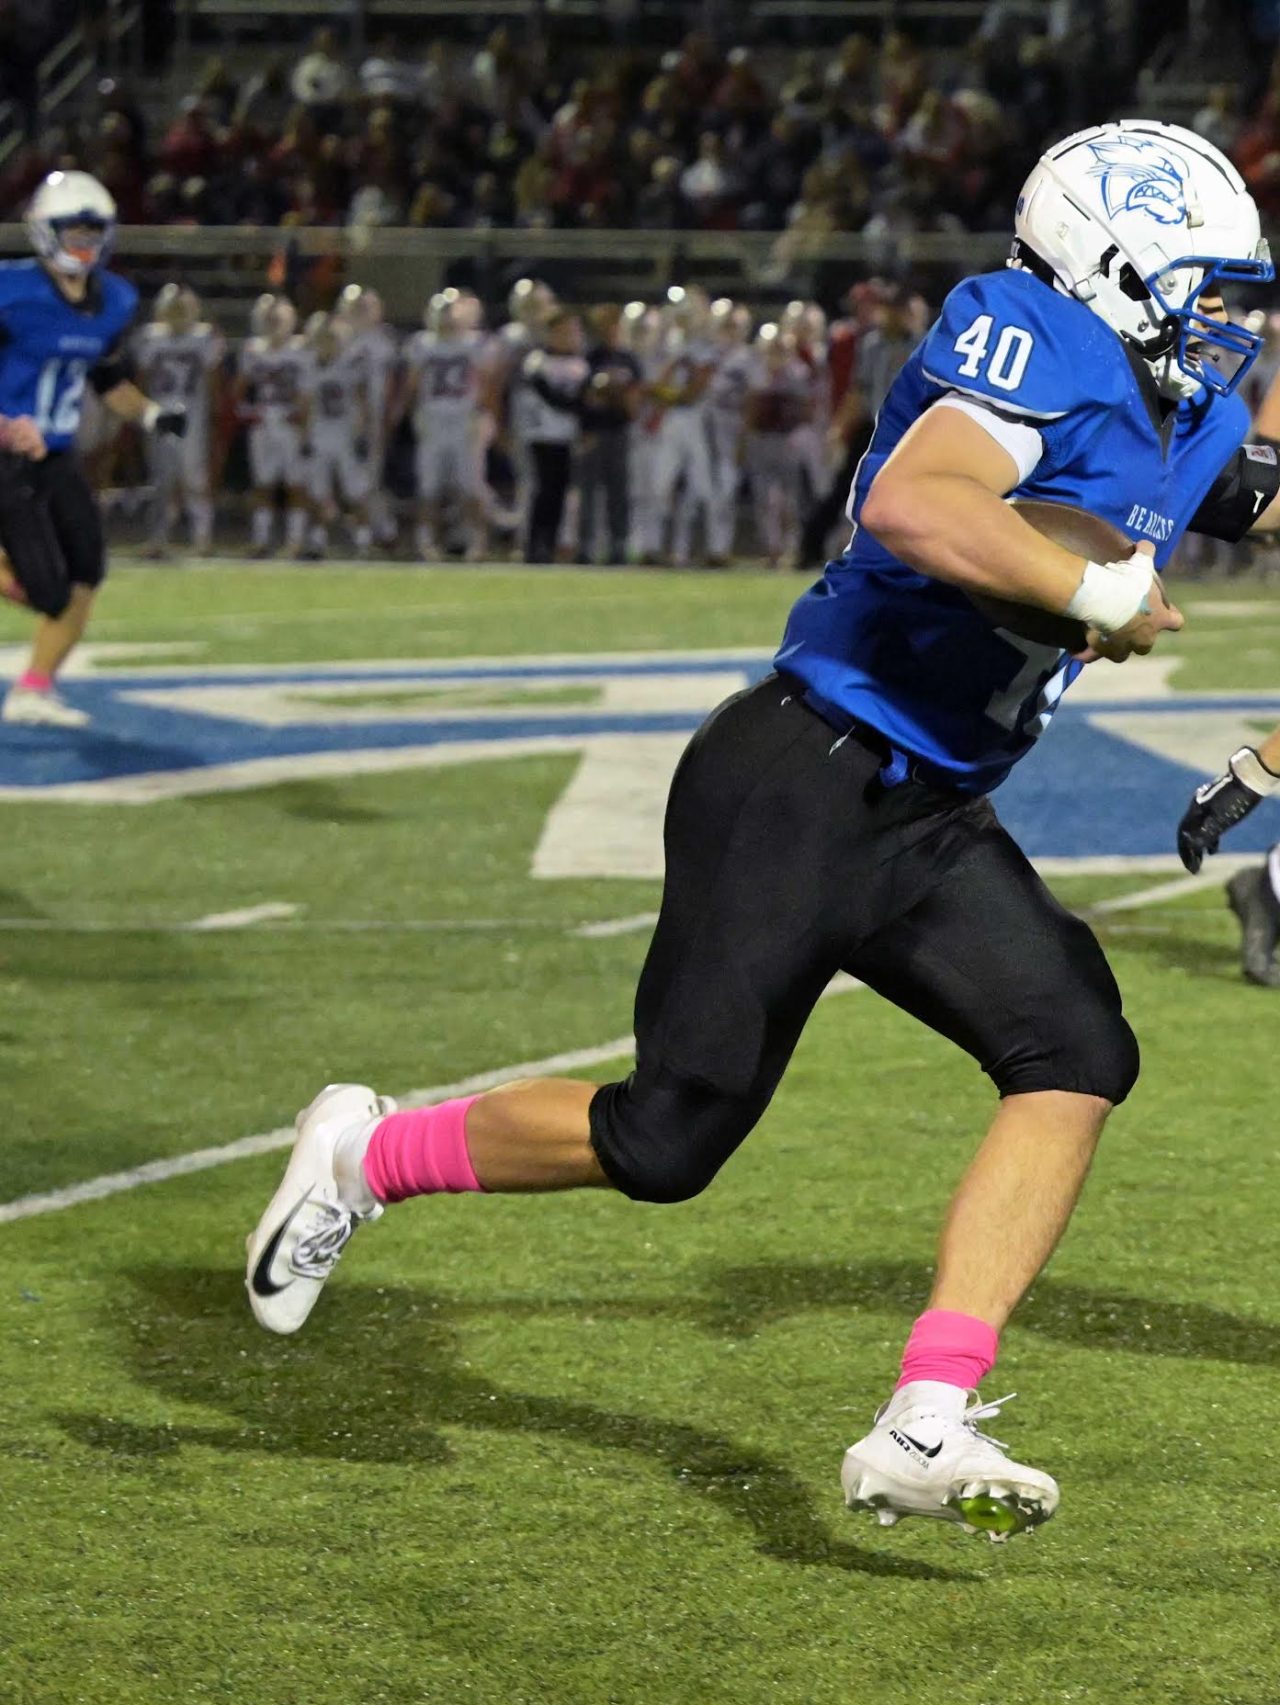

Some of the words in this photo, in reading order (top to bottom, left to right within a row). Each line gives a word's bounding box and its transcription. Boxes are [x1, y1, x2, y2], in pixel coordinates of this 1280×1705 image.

[953, 314, 1034, 392] 40
[36, 357, 87, 434] 12
[889, 1430, 911, 1452] AIR
